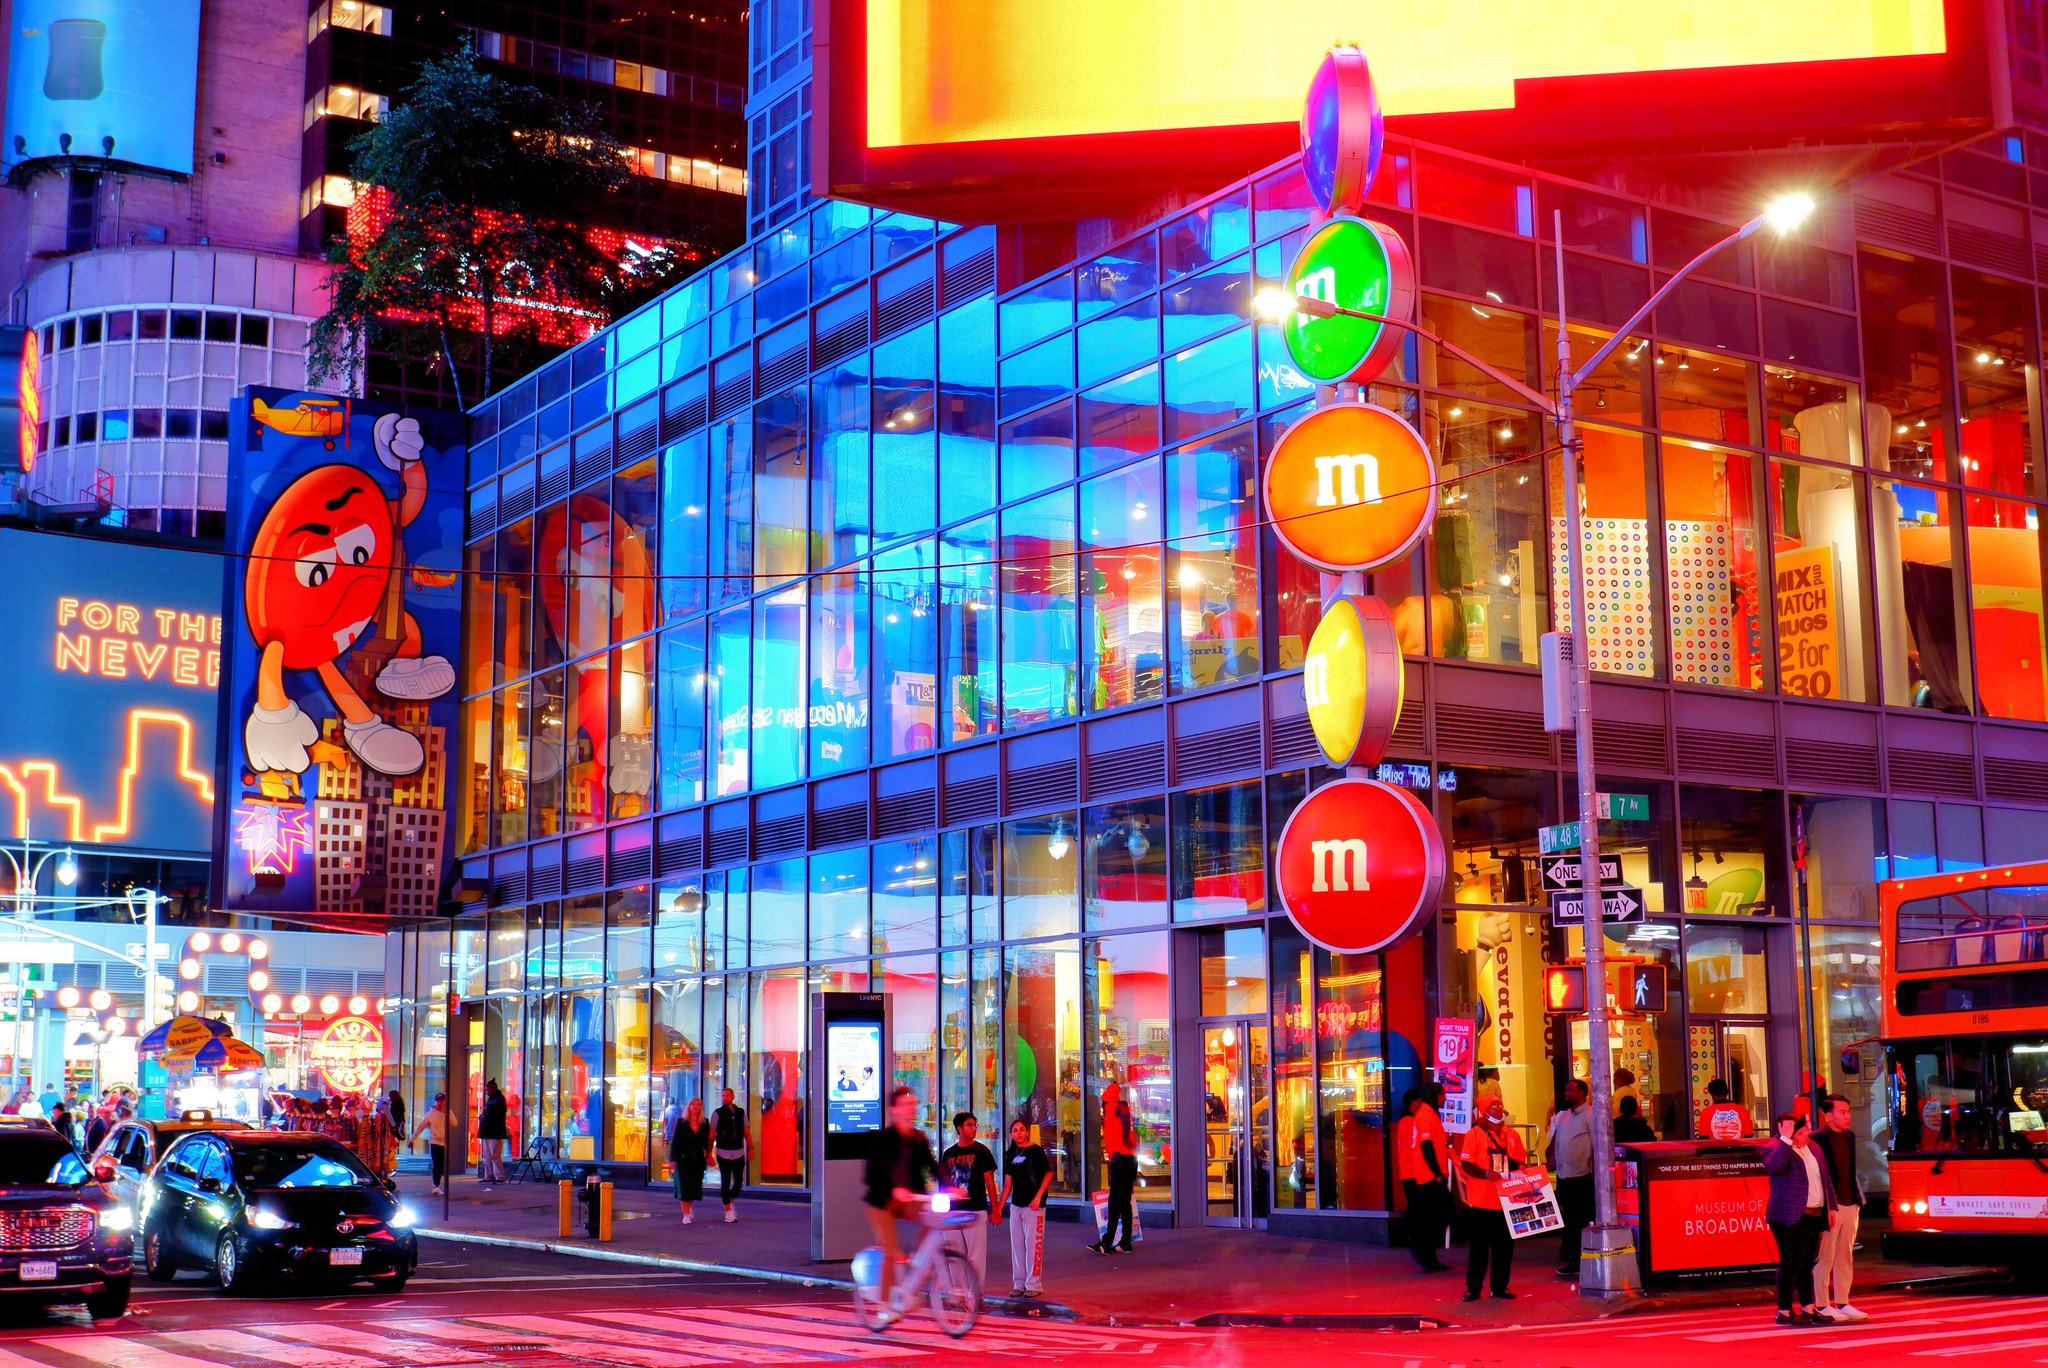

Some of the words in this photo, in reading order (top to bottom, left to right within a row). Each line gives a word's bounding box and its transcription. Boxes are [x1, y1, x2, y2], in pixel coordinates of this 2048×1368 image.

[1314, 453, 1383, 507] m
[57, 597, 141, 634] FOR
[1797, 638, 1830, 670] for
[1618, 797, 1626, 817] 7
[1629, 798, 1639, 810] Av
[1549, 829, 1558, 848] W
[1560, 827, 1572, 846] 48
[1312, 838, 1371, 892] m
[1554, 865, 1578, 880] ONE
[1599, 864, 1612, 877] AY
[1566, 902, 1583, 916] ON
[1604, 899, 1629, 914] WAY
[1496, 936, 1514, 1067] evator
[1438, 1024, 1454, 1032] NIGHT
[1972, 1014, 1989, 1025] 0186
[334, 1022, 371, 1040] HOT
[1502, 1179, 1524, 1189] ICONIC
[1524, 1173, 1543, 1184] TOUR
[1695, 1201, 1745, 1214] MUSEUM
[1748, 1199, 1763, 1212] OF
[1956, 1200, 1984, 1209] DONATE
[1988, 1200, 2005, 1209] SAVE
[2009, 1201, 2032, 1209] LIVES
[1032, 1214, 1044, 1277] RUTGERS
